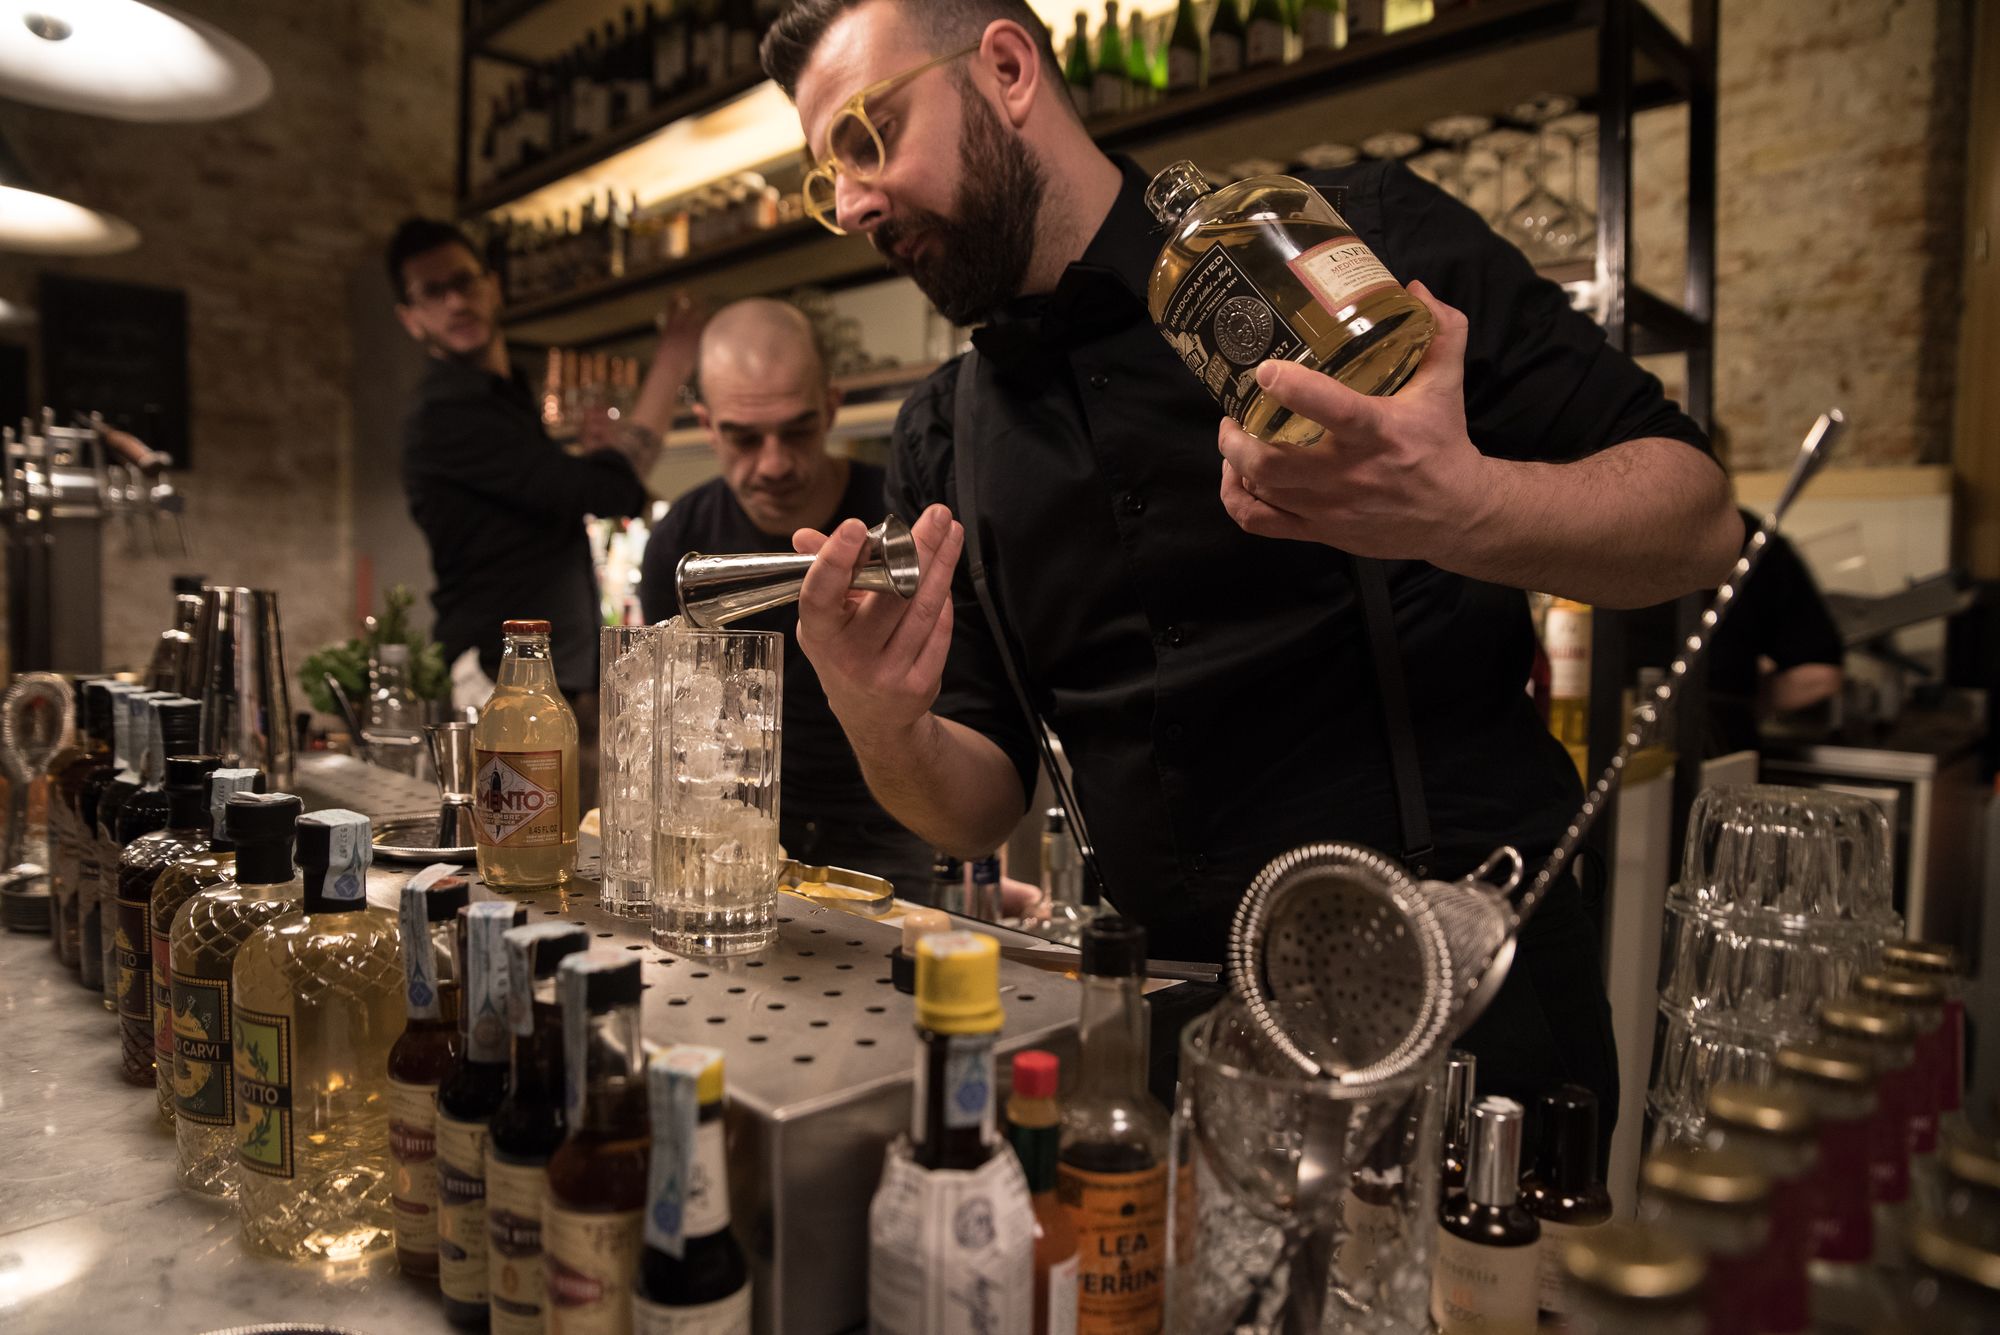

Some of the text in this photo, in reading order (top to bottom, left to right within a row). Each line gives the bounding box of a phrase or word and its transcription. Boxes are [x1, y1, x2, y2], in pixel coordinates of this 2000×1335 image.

[1169, 255, 1224, 328] HANDCRAFTED
[1192, 276, 1238, 331] ITALIAN PREMIUM DRY
[182, 1039, 220, 1060] CARVI
[1098, 1232, 1149, 1257] LEA
